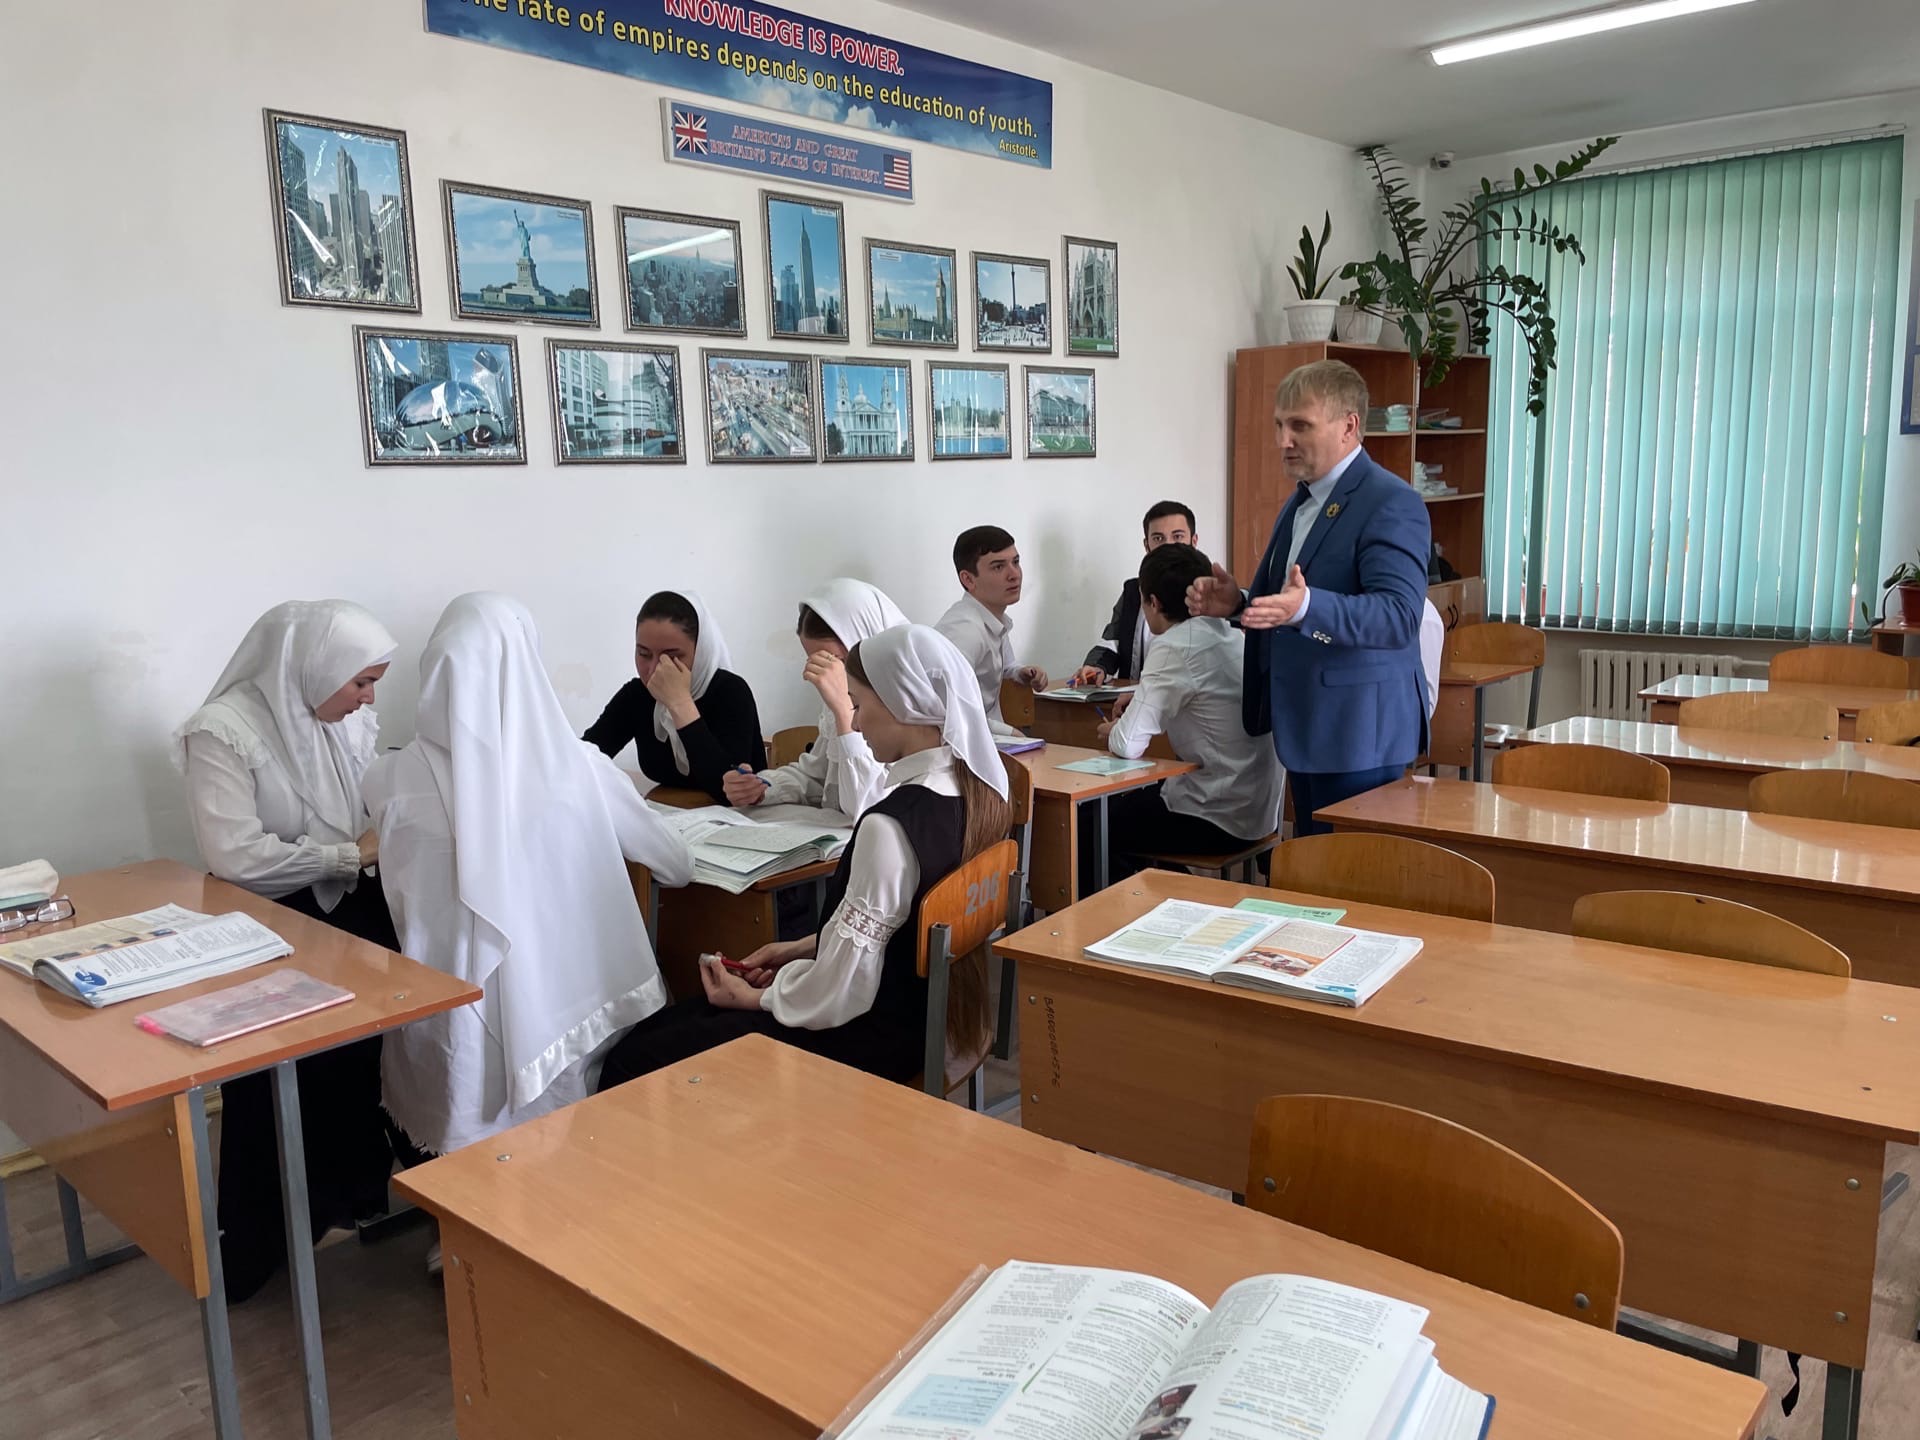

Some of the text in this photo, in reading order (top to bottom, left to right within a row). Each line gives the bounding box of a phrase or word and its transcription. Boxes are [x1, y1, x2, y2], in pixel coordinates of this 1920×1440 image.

[664, 0, 905, 76] KNOWLEDGE IS POWER.
[579, 10, 606, 35] of
[612, 20, 710, 61] empires
[717, 42, 808, 84] depends
[813, 70, 837, 92] on
[843, 74, 875, 100] the
[879, 85, 965, 121] education
[968, 106, 986, 126] of
[989, 113, 1038, 139] youth.
[794, 137, 820, 155] AND
[823, 143, 858, 163] GREAT
[999, 138, 1040, 160] Aristotle.
[769, 150, 809, 172] PLACES
[812, 159, 828, 175] OF
